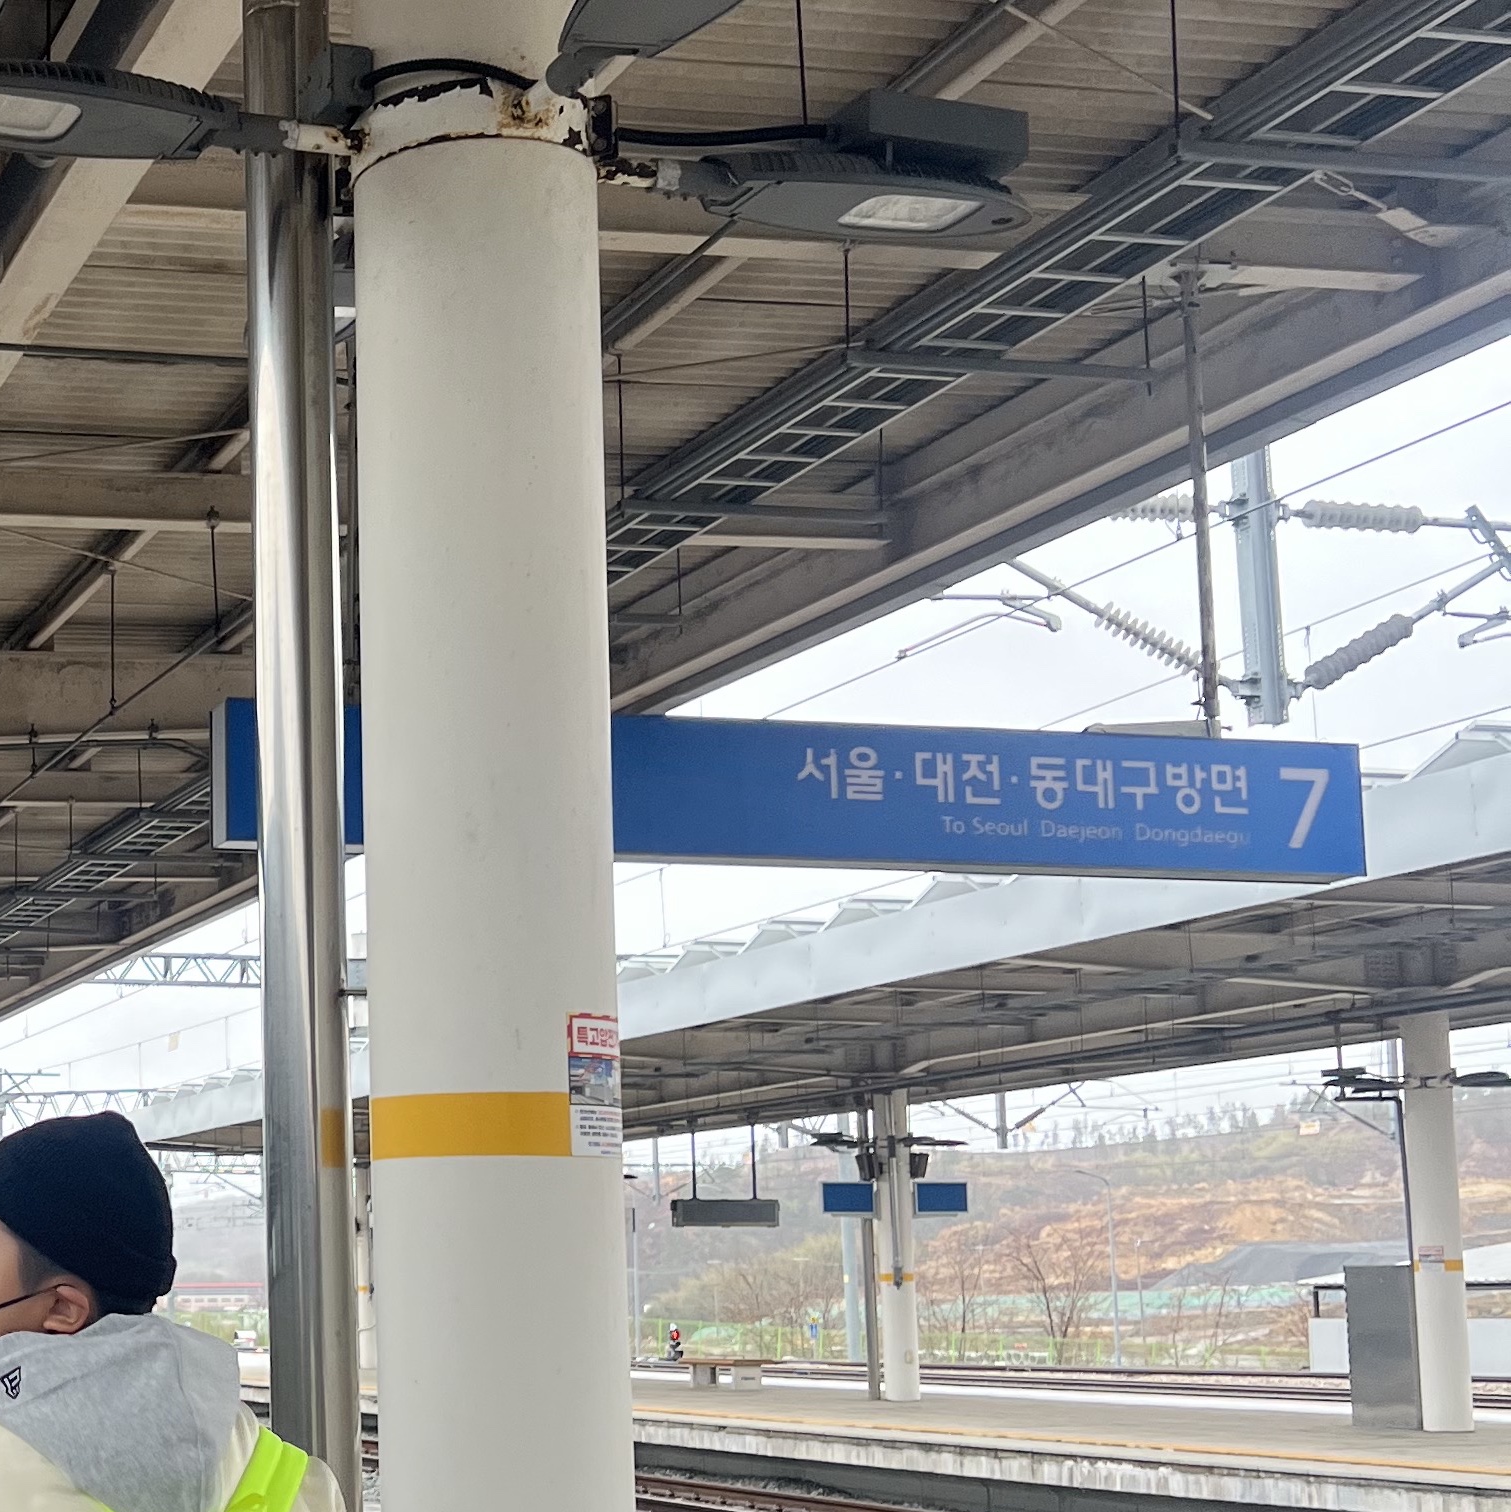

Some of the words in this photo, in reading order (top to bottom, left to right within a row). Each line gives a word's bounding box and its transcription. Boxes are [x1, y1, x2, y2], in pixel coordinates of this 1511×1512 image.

[942, 815, 965, 834] To
[971, 816, 1028, 836] Seoul
[1041, 820, 1123, 842] Daejeon
[1279, 767, 1329, 849] 7
